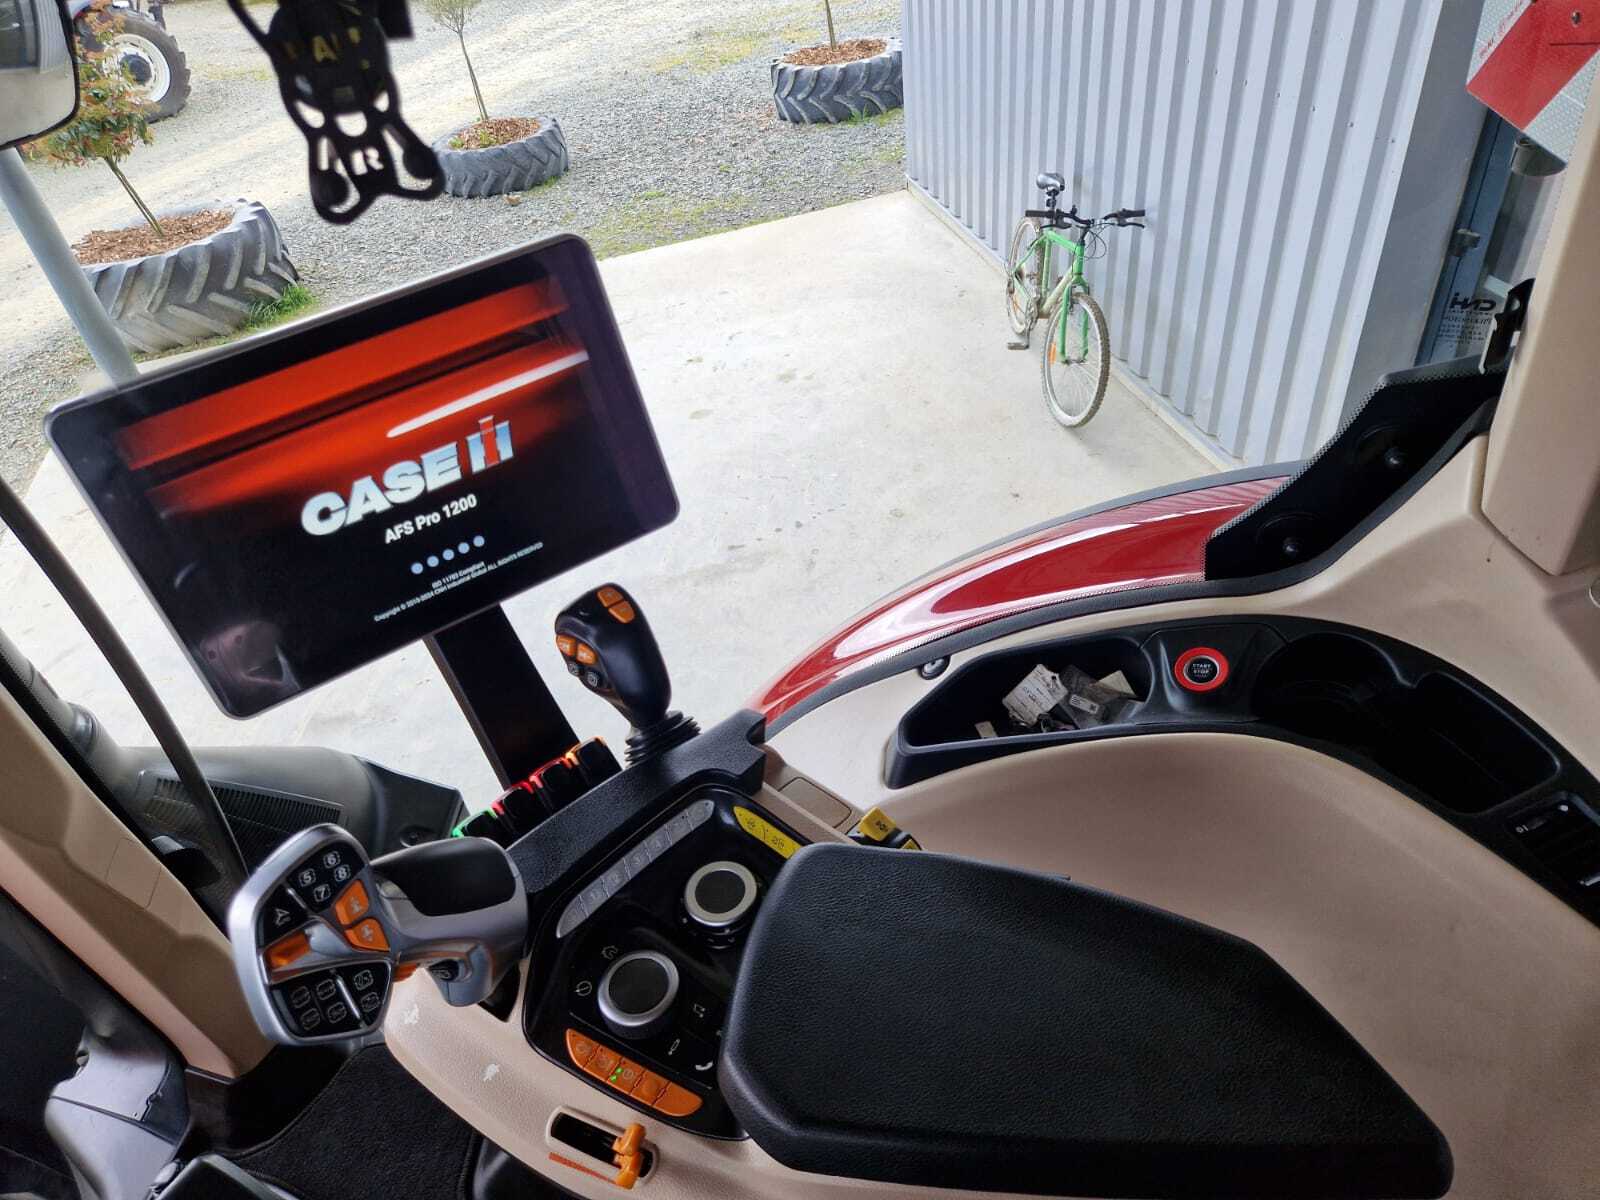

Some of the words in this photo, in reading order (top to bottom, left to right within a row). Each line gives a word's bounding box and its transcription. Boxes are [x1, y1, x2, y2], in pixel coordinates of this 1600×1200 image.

[301, 441, 462, 536] CASE
[385, 520, 415, 544] AFS
[414, 511, 441, 530] Pro
[442, 493, 478, 518] 1200
[327, 853, 336, 864] 6
[303, 873, 312, 881] 5
[339, 866, 347, 879] 8
[317, 886, 326, 899] 7
